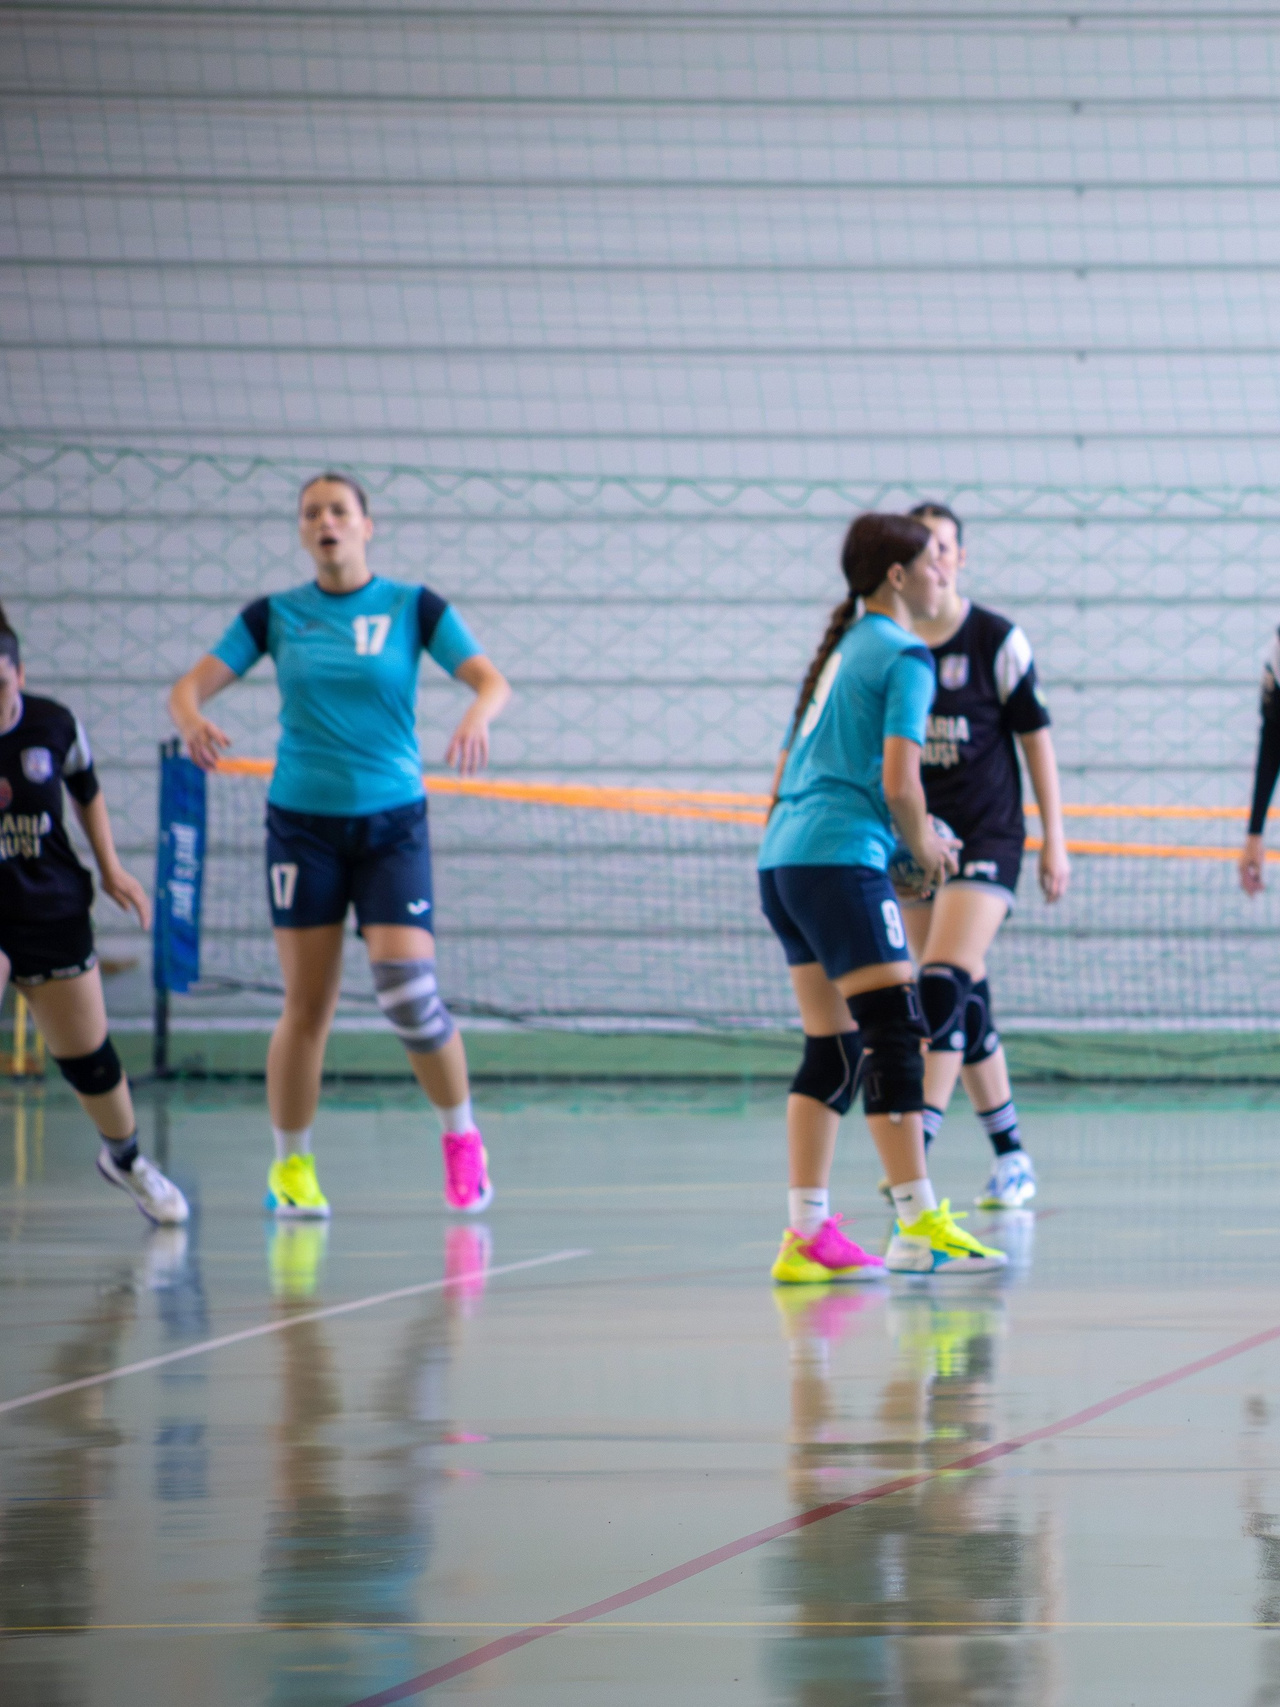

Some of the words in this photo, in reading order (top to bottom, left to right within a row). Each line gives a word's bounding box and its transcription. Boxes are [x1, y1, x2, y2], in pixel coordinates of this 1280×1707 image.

[353, 614, 391, 656] 17
[926, 714, 970, 742] ARIA
[0, 811, 52, 836] ARIA
[271, 863, 299, 910] 17
[881, 899, 905, 949] 9
